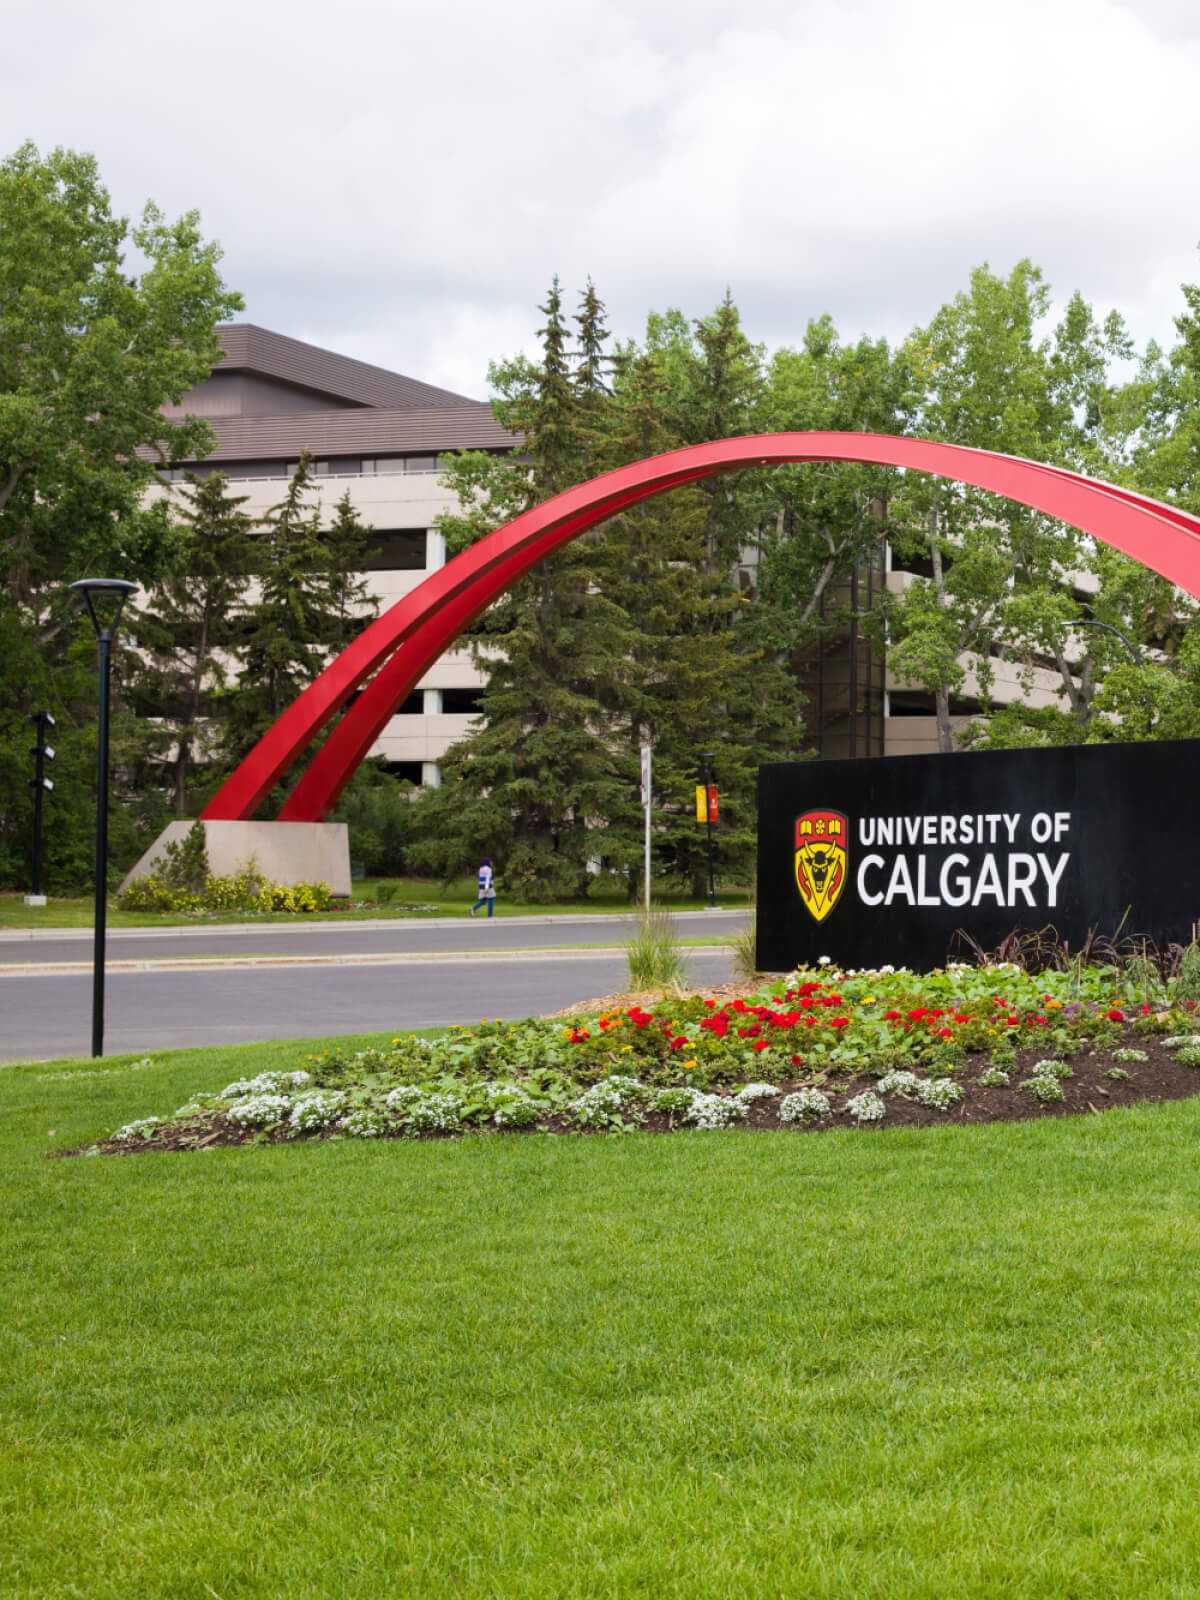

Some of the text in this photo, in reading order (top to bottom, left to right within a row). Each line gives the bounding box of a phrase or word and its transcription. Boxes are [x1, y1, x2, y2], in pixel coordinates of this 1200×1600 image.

[858, 811, 1071, 845] UNIVERSITY OF
[857, 852, 1071, 907] CALGARY
